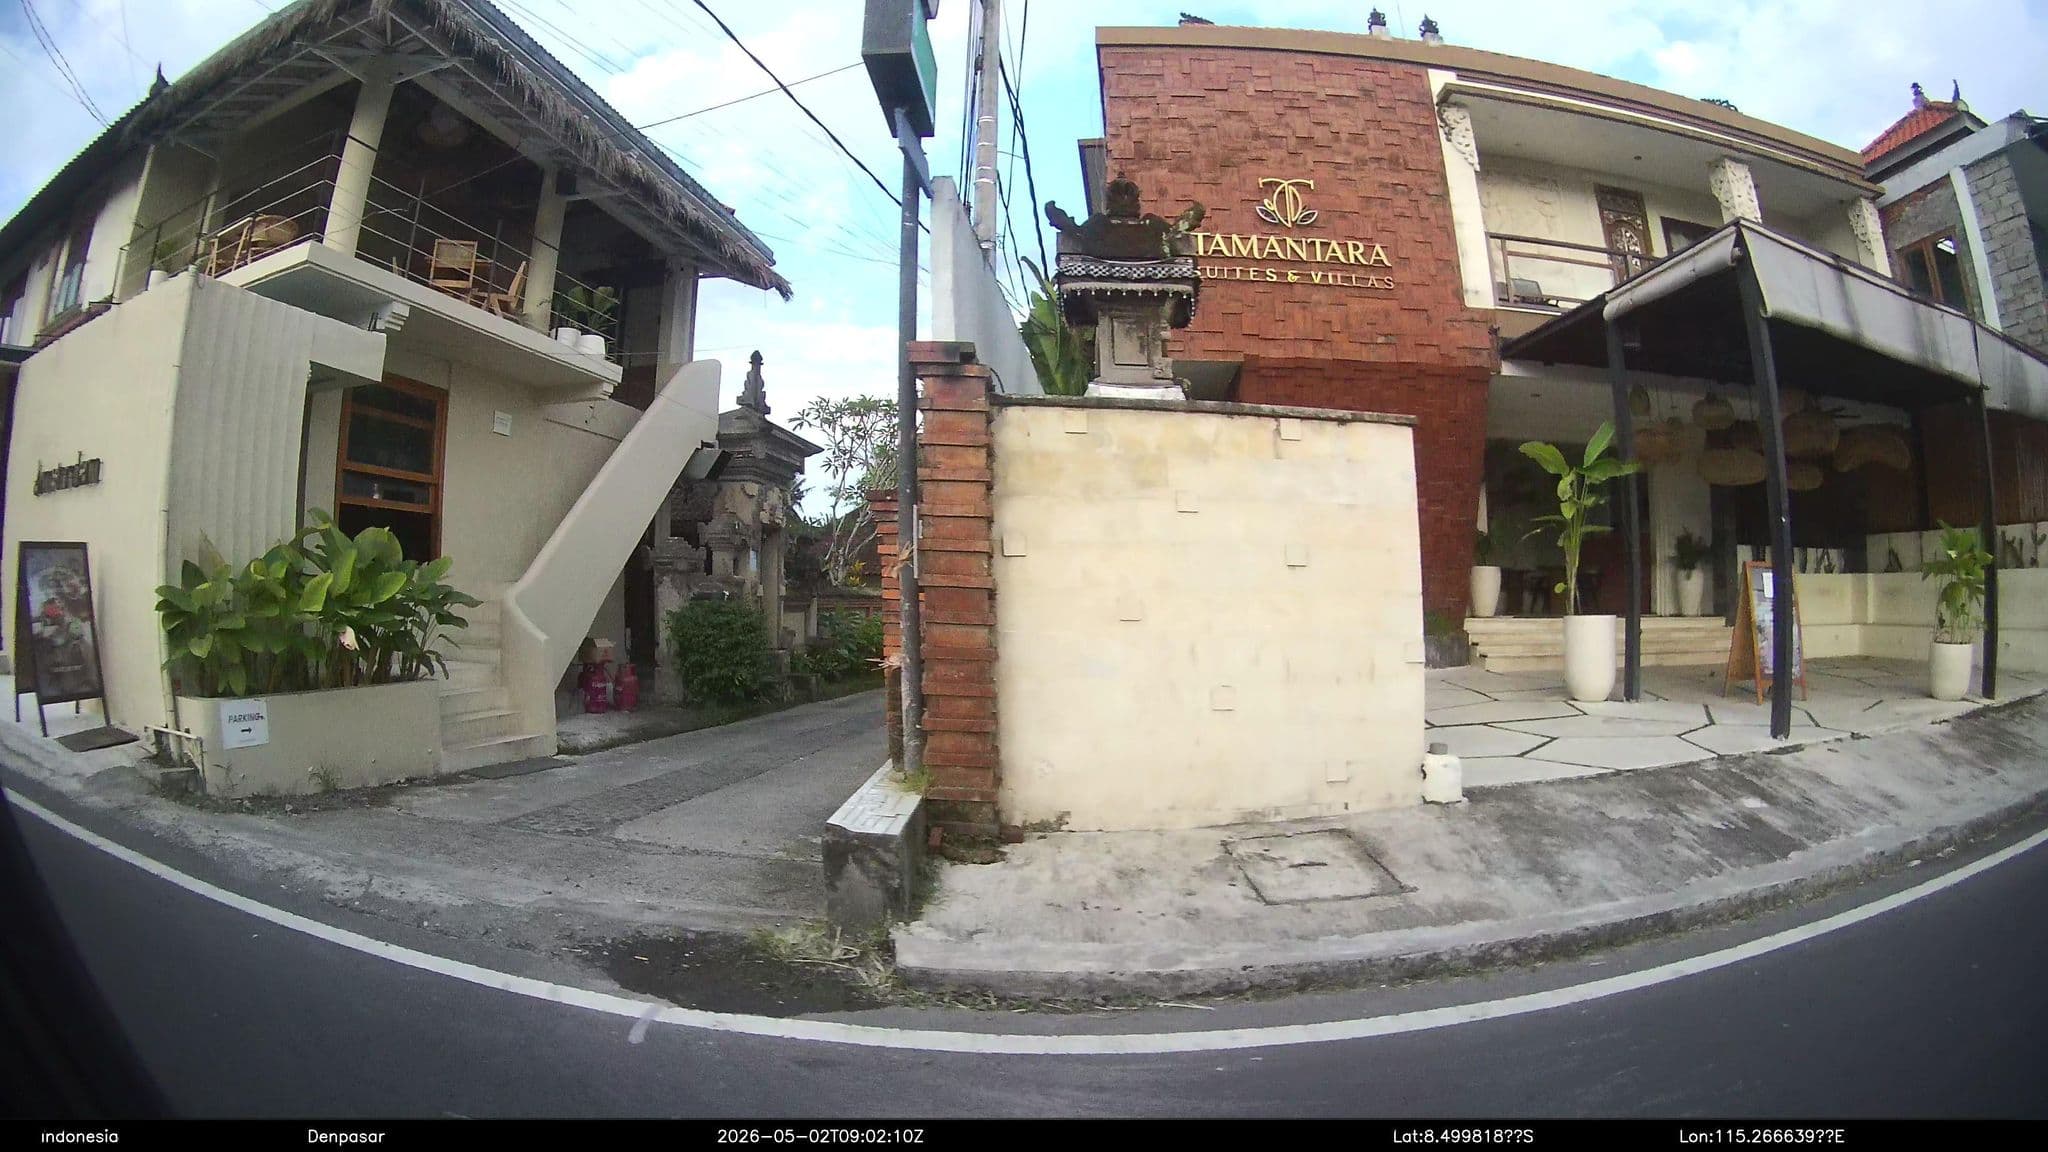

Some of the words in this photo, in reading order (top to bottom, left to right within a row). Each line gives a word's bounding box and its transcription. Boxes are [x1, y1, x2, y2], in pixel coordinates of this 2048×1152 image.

[1190, 232, 1391, 267] TAMANTARA
[1287, 270, 1300, 283] &
[1311, 271, 1395, 289] VILLAS
[227, 712, 263, 723] PARKING
